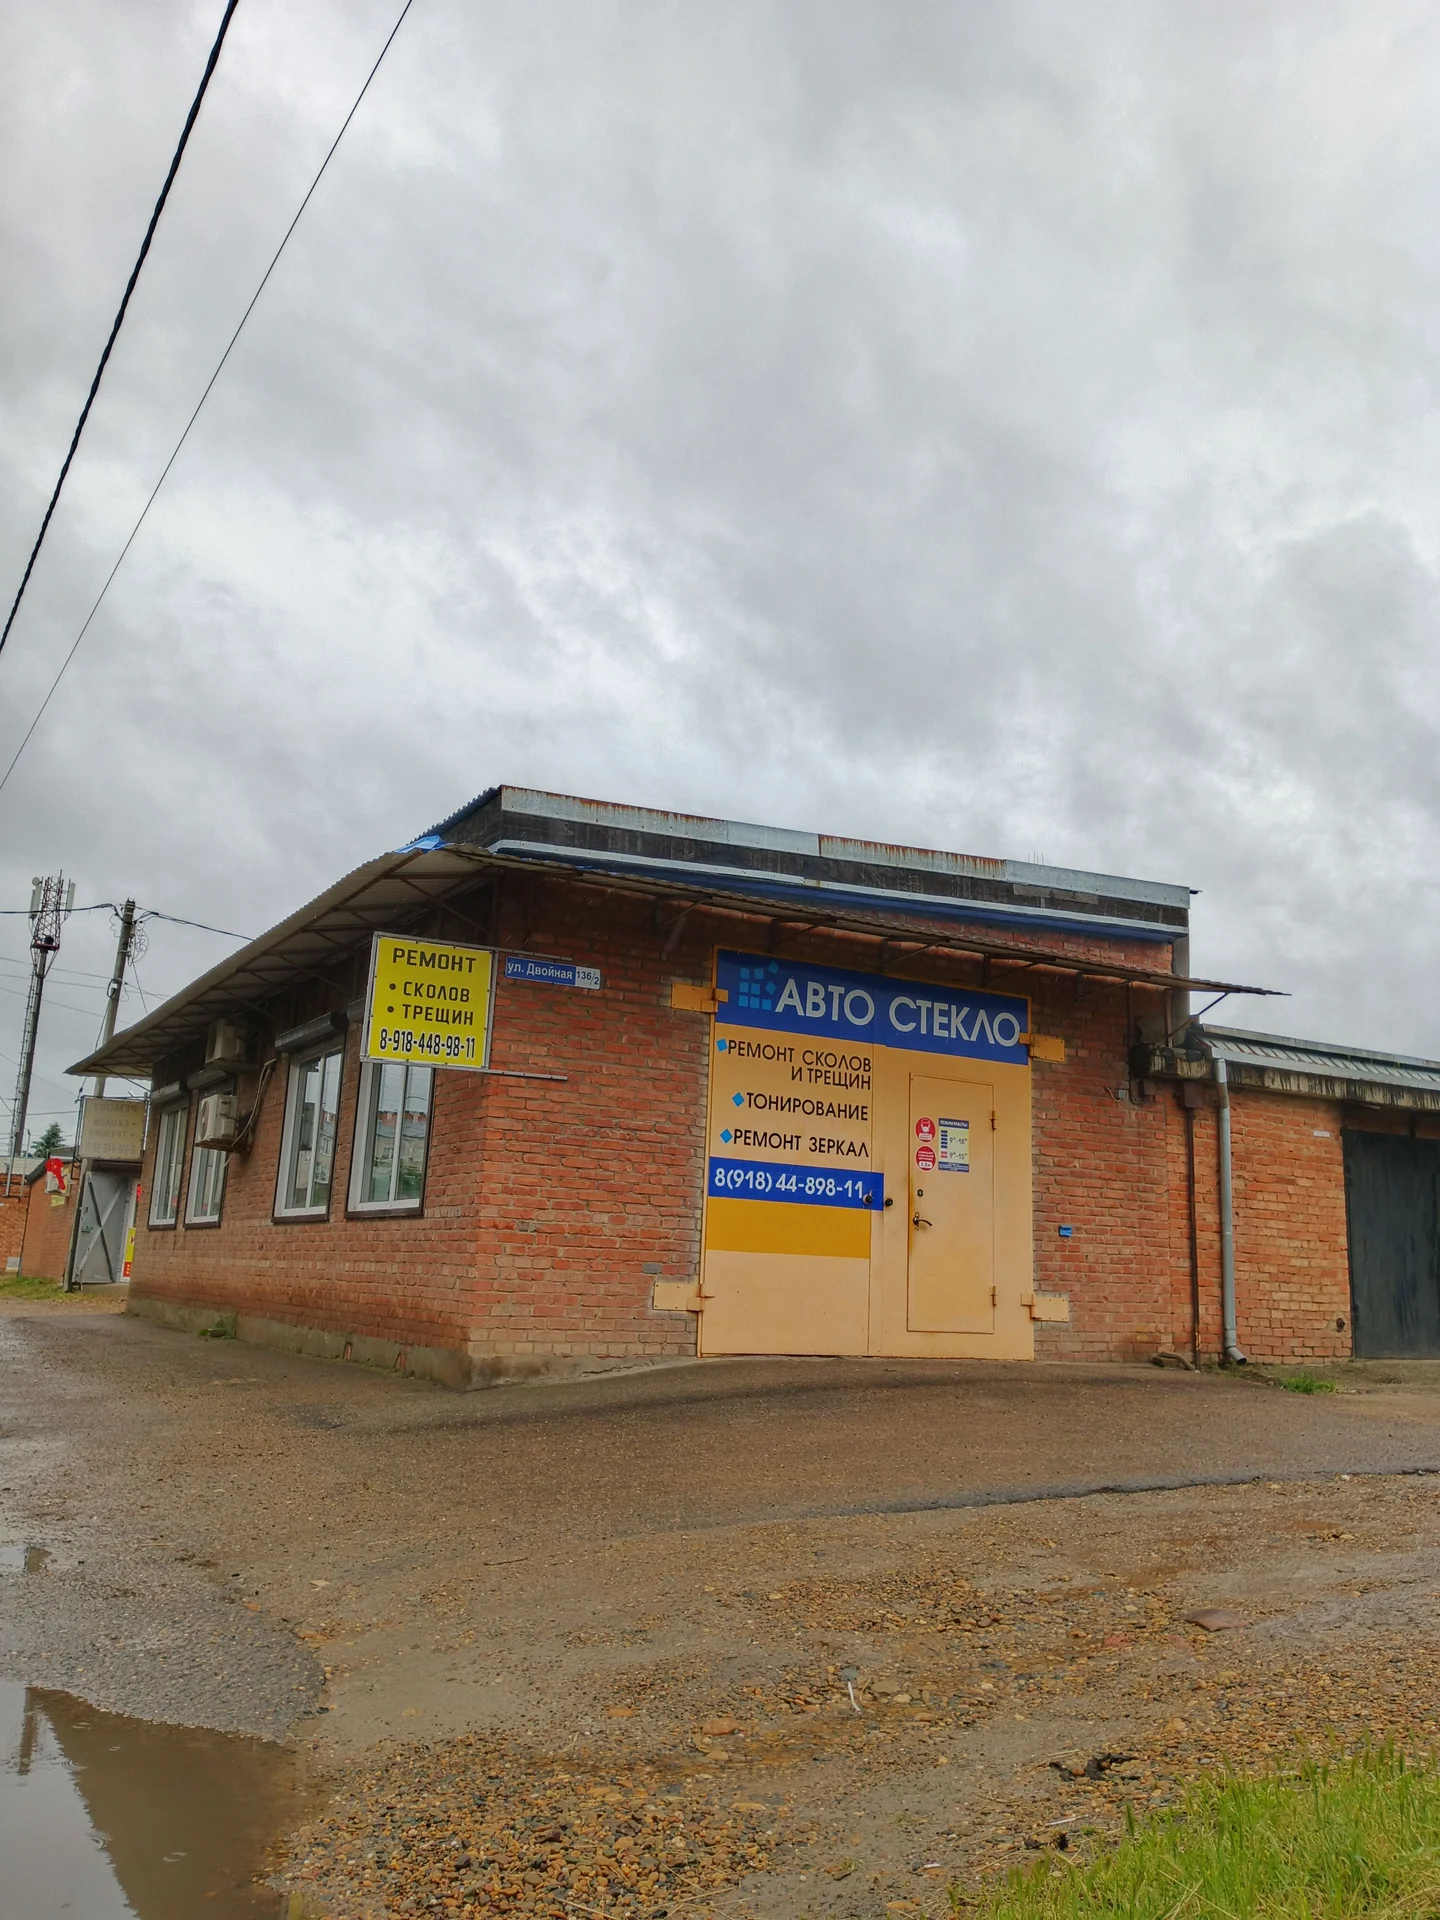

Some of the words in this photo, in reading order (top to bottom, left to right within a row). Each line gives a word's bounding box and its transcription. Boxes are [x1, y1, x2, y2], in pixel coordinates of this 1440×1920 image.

[392, 947, 477, 973] РЕМОНТ
[507, 961, 524, 974] ул.
[526, 962, 573, 980] Двойная
[576, 970, 599, 986] 136/2
[403, 981, 470, 1003] СКОЛОВ
[401, 1003, 474, 1026] ТРЕЩИН
[775, 978, 875, 1026] АВТО
[889, 996, 1021, 1047] СТЕКЛО
[379, 1028, 476, 1059] 8-918-448-98-11
[728, 1039, 795, 1063] РЕМОНТ
[802, 1049, 872, 1072] СКОЛОВ
[791, 1065, 803, 1082] И
[807, 1067, 872, 1091] ТРЕЩИН
[746, 1092, 868, 1121] ТОНИРОВАНИЕ
[733, 1128, 802, 1151] РЕМОНТ
[808, 1137, 869, 1158] ЗЕРКАЛ
